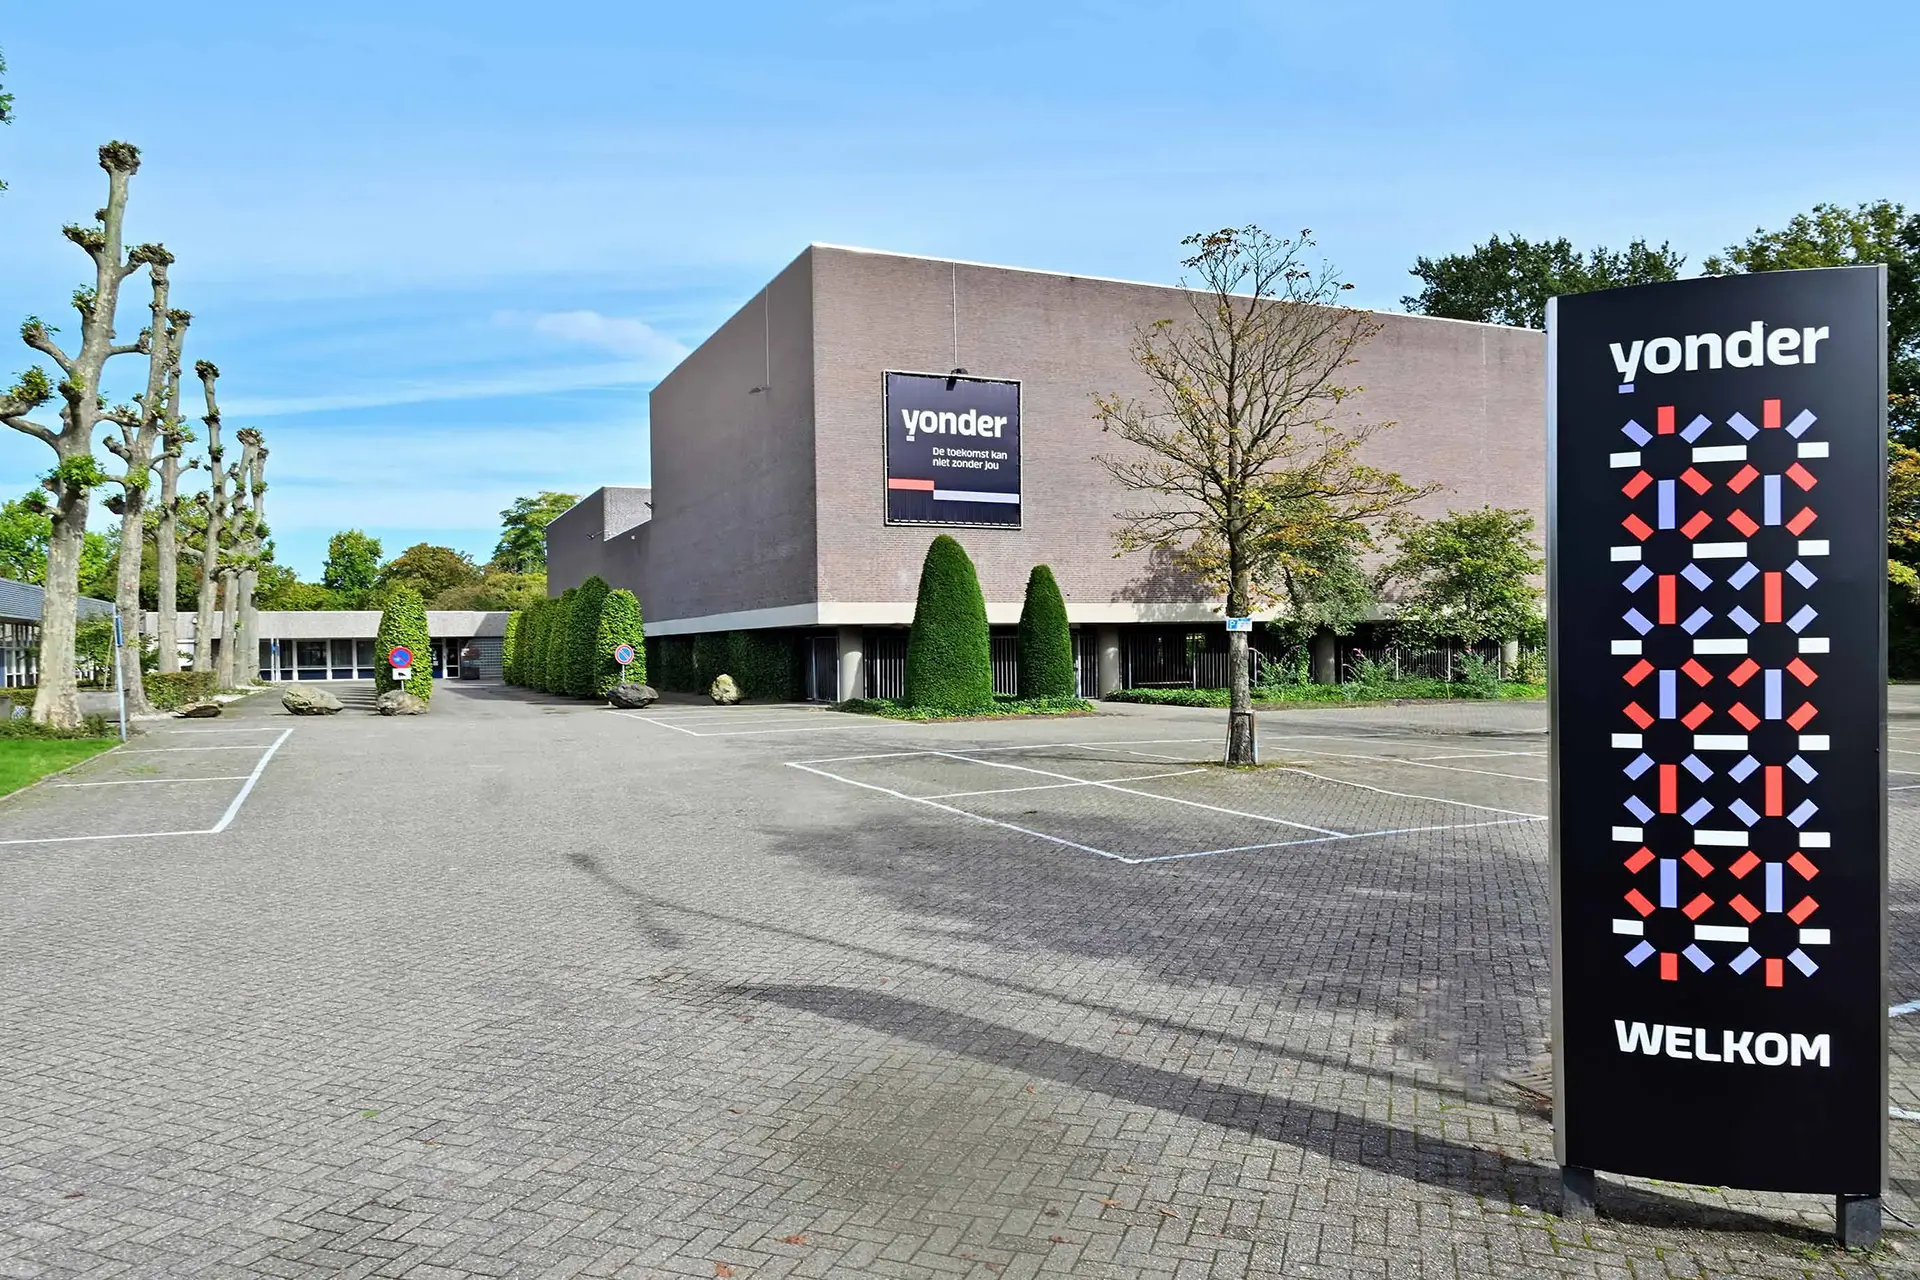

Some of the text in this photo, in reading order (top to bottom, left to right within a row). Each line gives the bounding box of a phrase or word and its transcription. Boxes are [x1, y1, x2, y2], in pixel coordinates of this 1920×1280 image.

[1609, 321, 1830, 384] yonder
[901, 409, 1008, 439] yonder
[932, 447, 1008, 460] De toekomst kan
[932, 458, 1000, 471] niet zonder jou
[1614, 1019, 1831, 1068] WELKOM
